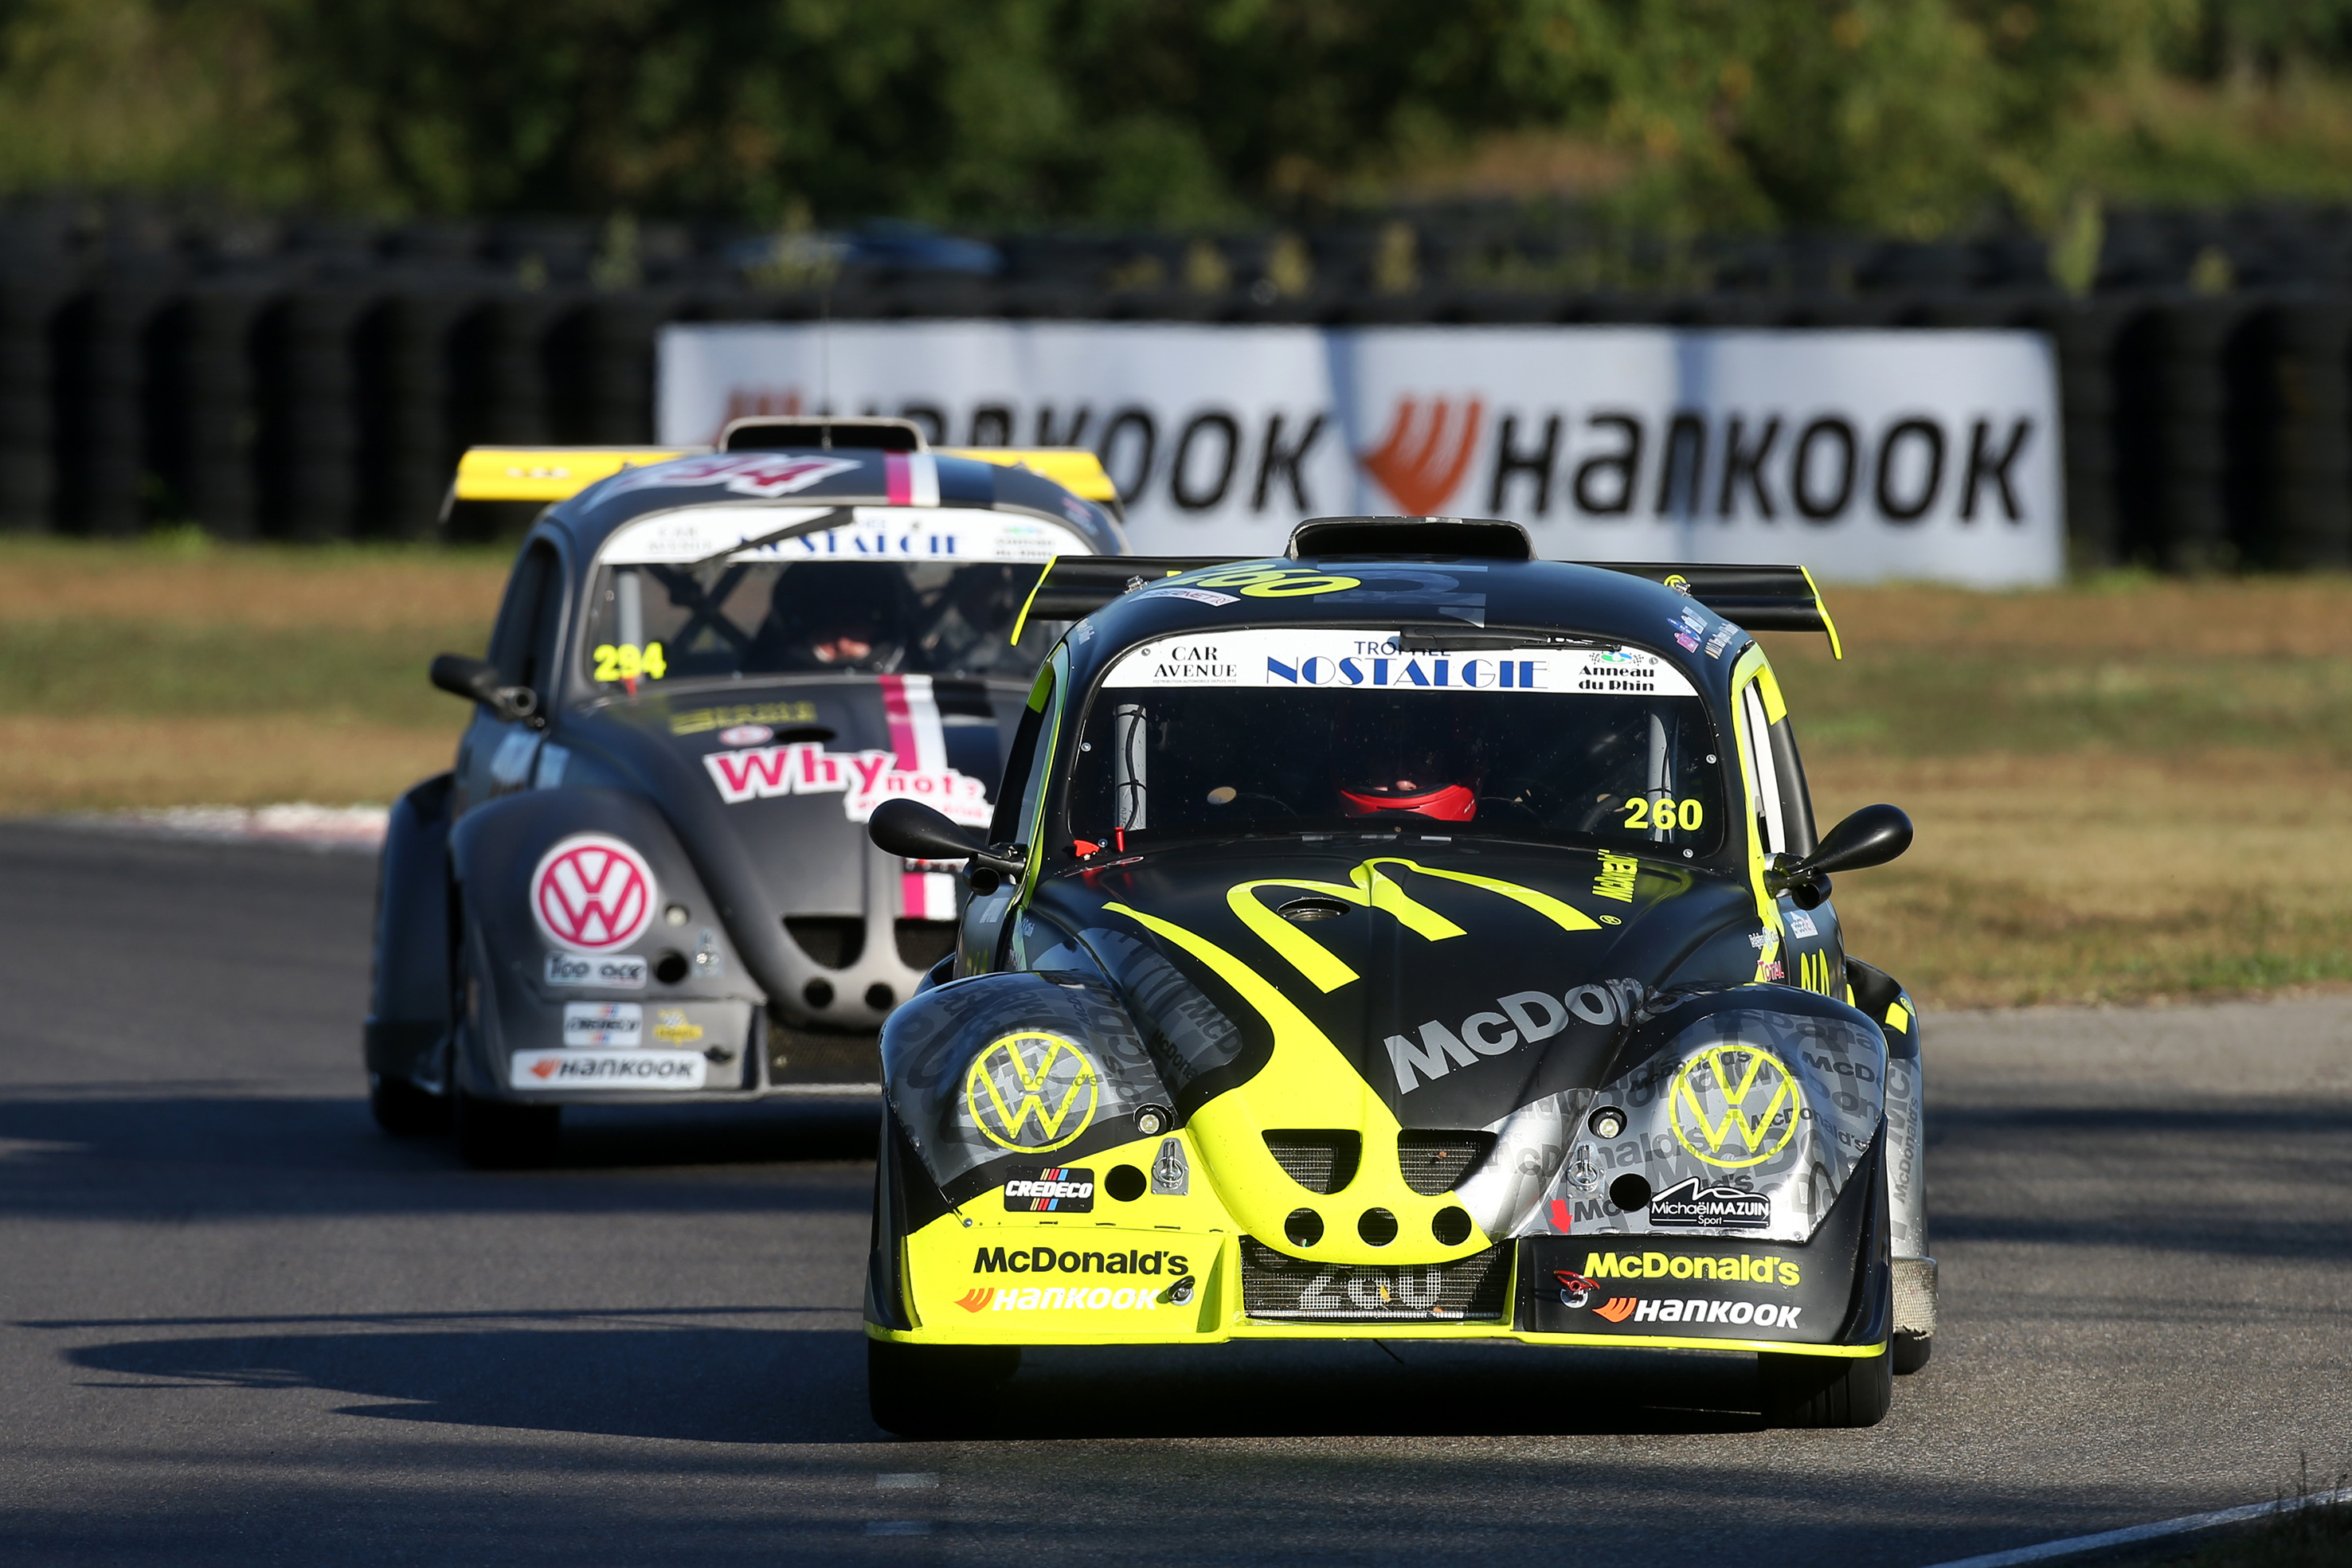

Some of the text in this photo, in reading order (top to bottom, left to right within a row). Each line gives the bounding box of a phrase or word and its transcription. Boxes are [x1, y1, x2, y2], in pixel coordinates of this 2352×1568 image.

[593, 642, 667, 682] 294
[1172, 646, 1218, 661] CAR
[1153, 663, 1237, 677] AVENUE
[1266, 656, 1548, 689] NOSTALGIE
[1579, 665, 1654, 678] Anneau
[1579, 679, 1654, 691] du Rhin
[714, 744, 889, 795] Why
[1624, 797, 1703, 831] 260
[1757, 959, 1786, 982] TOTAL
[1005, 1180, 1093, 1198] CREDECO
[1697, 1215, 1723, 1226] Sport
[973, 1247, 1189, 1275] McDonald's
[1583, 1252, 1801, 1286] McDonald's
